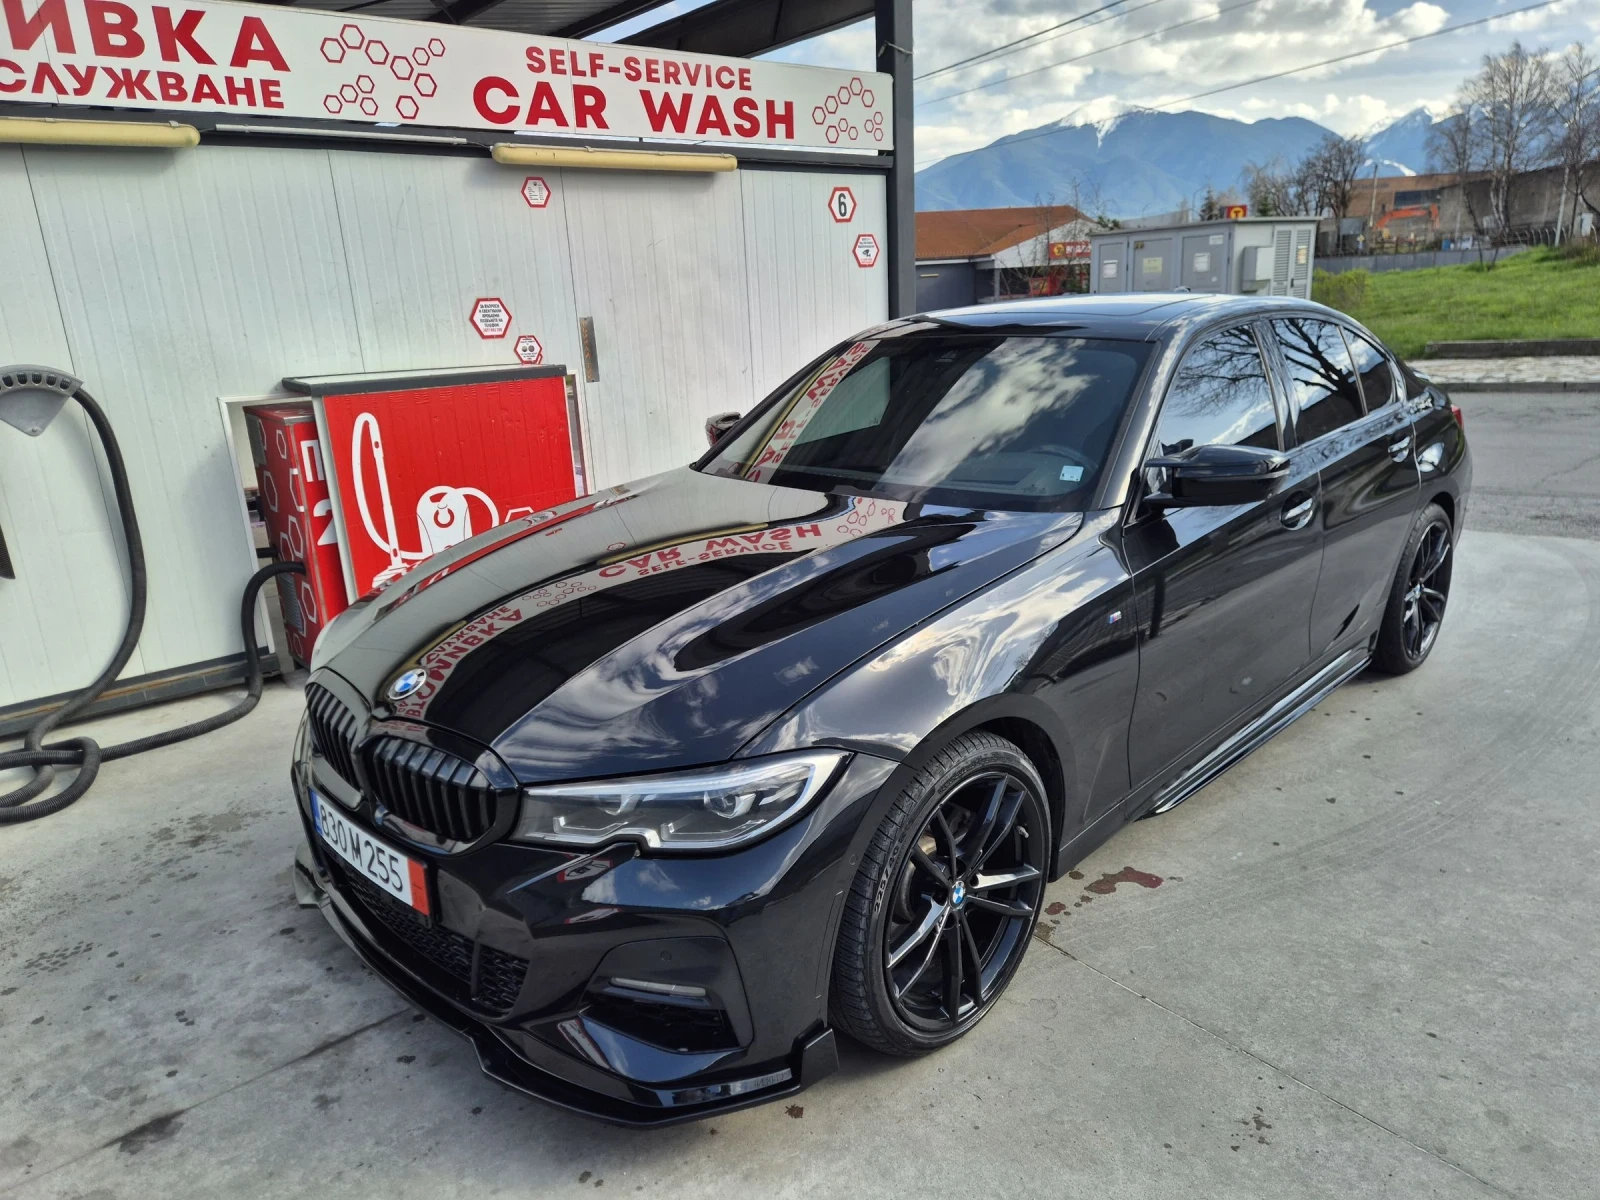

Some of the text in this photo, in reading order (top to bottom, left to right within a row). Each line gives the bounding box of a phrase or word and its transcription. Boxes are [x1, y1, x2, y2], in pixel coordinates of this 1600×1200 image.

[3, 0, 291, 72] ИВКА
[0, 59, 285, 109] СЛУЖВАНЕ
[525, 46, 752, 91] SELF-SERVICE
[473, 75, 795, 140] CAR WASH
[838, 192, 847, 217] 6
[313, 498, 338, 546] 2
[320, 804, 403, 893] 830 M 255
